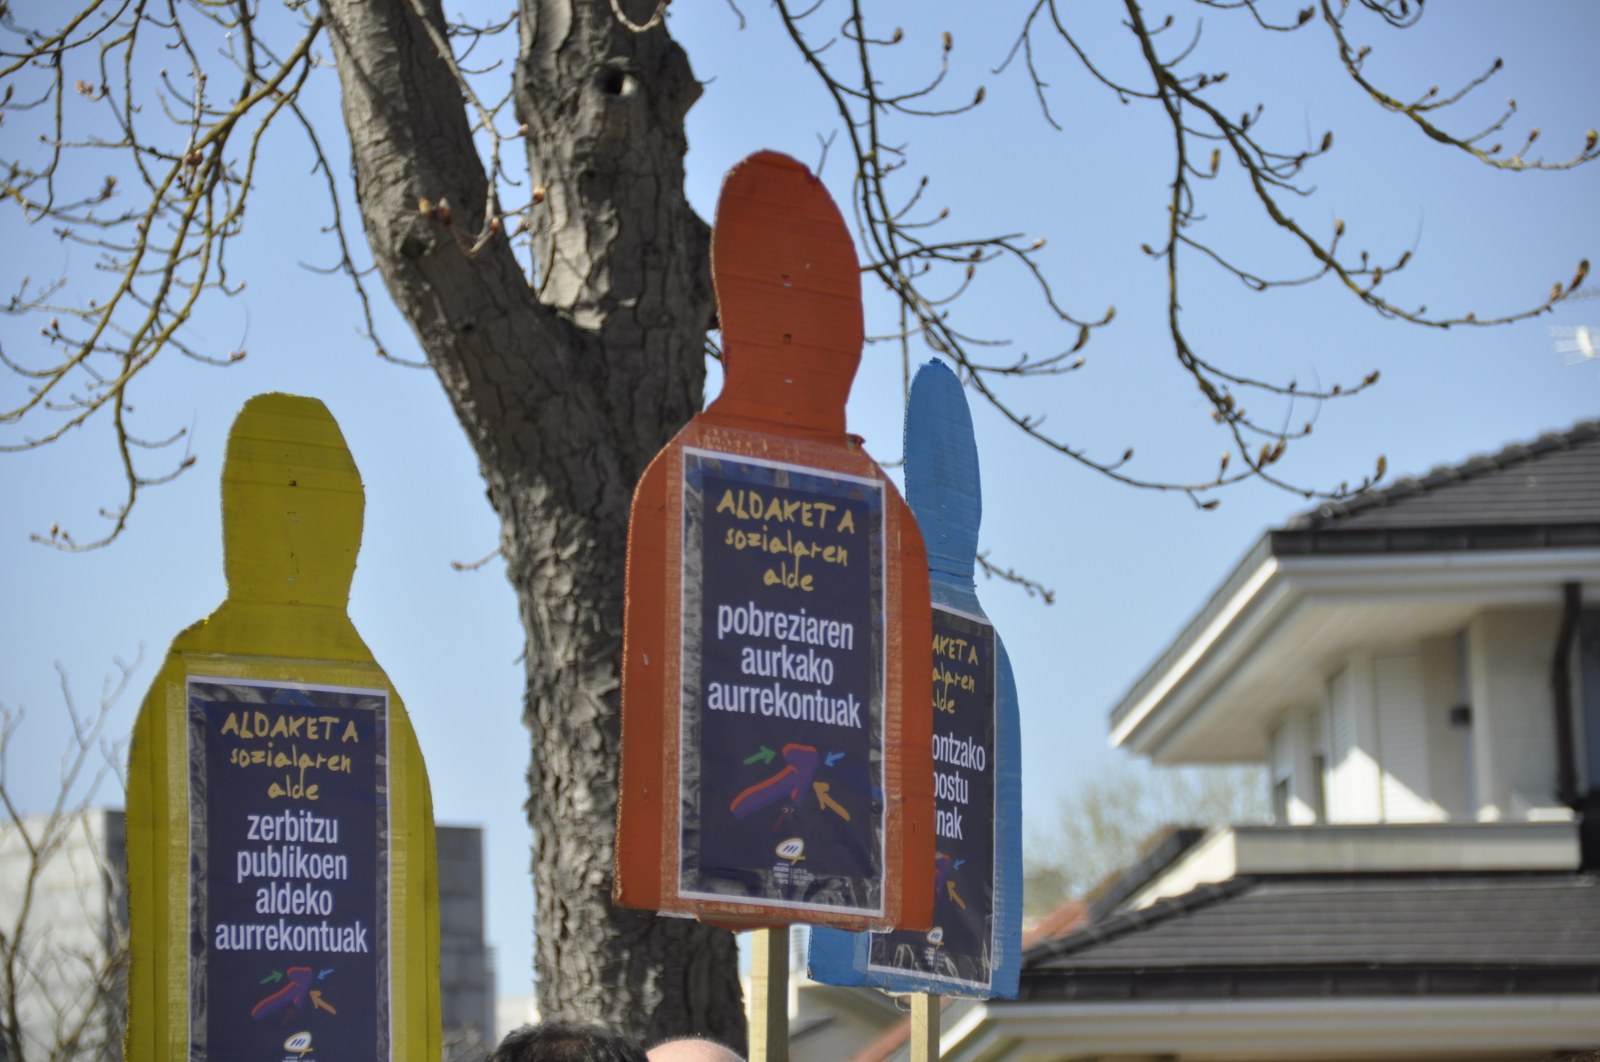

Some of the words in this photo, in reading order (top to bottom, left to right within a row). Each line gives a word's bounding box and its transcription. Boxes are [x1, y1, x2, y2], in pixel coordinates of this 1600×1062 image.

[716, 489, 855, 535] ALDAKETA
[725, 524, 849, 567] sozialaren
[763, 564, 815, 592] alde
[717, 602, 854, 651] pobreziaren
[740, 644, 834, 686] aurkako
[932, 634, 979, 666] AKETA
[932, 662, 975, 693] alaren
[707, 678, 862, 729] aurrekontuak
[931, 688, 956, 714] lde
[220, 711, 358, 744] ALDAKETA
[230, 743, 352, 774] sozialaren
[932, 732, 986, 771] ontzako
[267, 773, 320, 801] alde
[247, 809, 338, 844] zerbitzu
[236, 845, 348, 884] publikoen
[255, 881, 333, 916] aldeko
[214, 918, 368, 953] aurrekontuak
